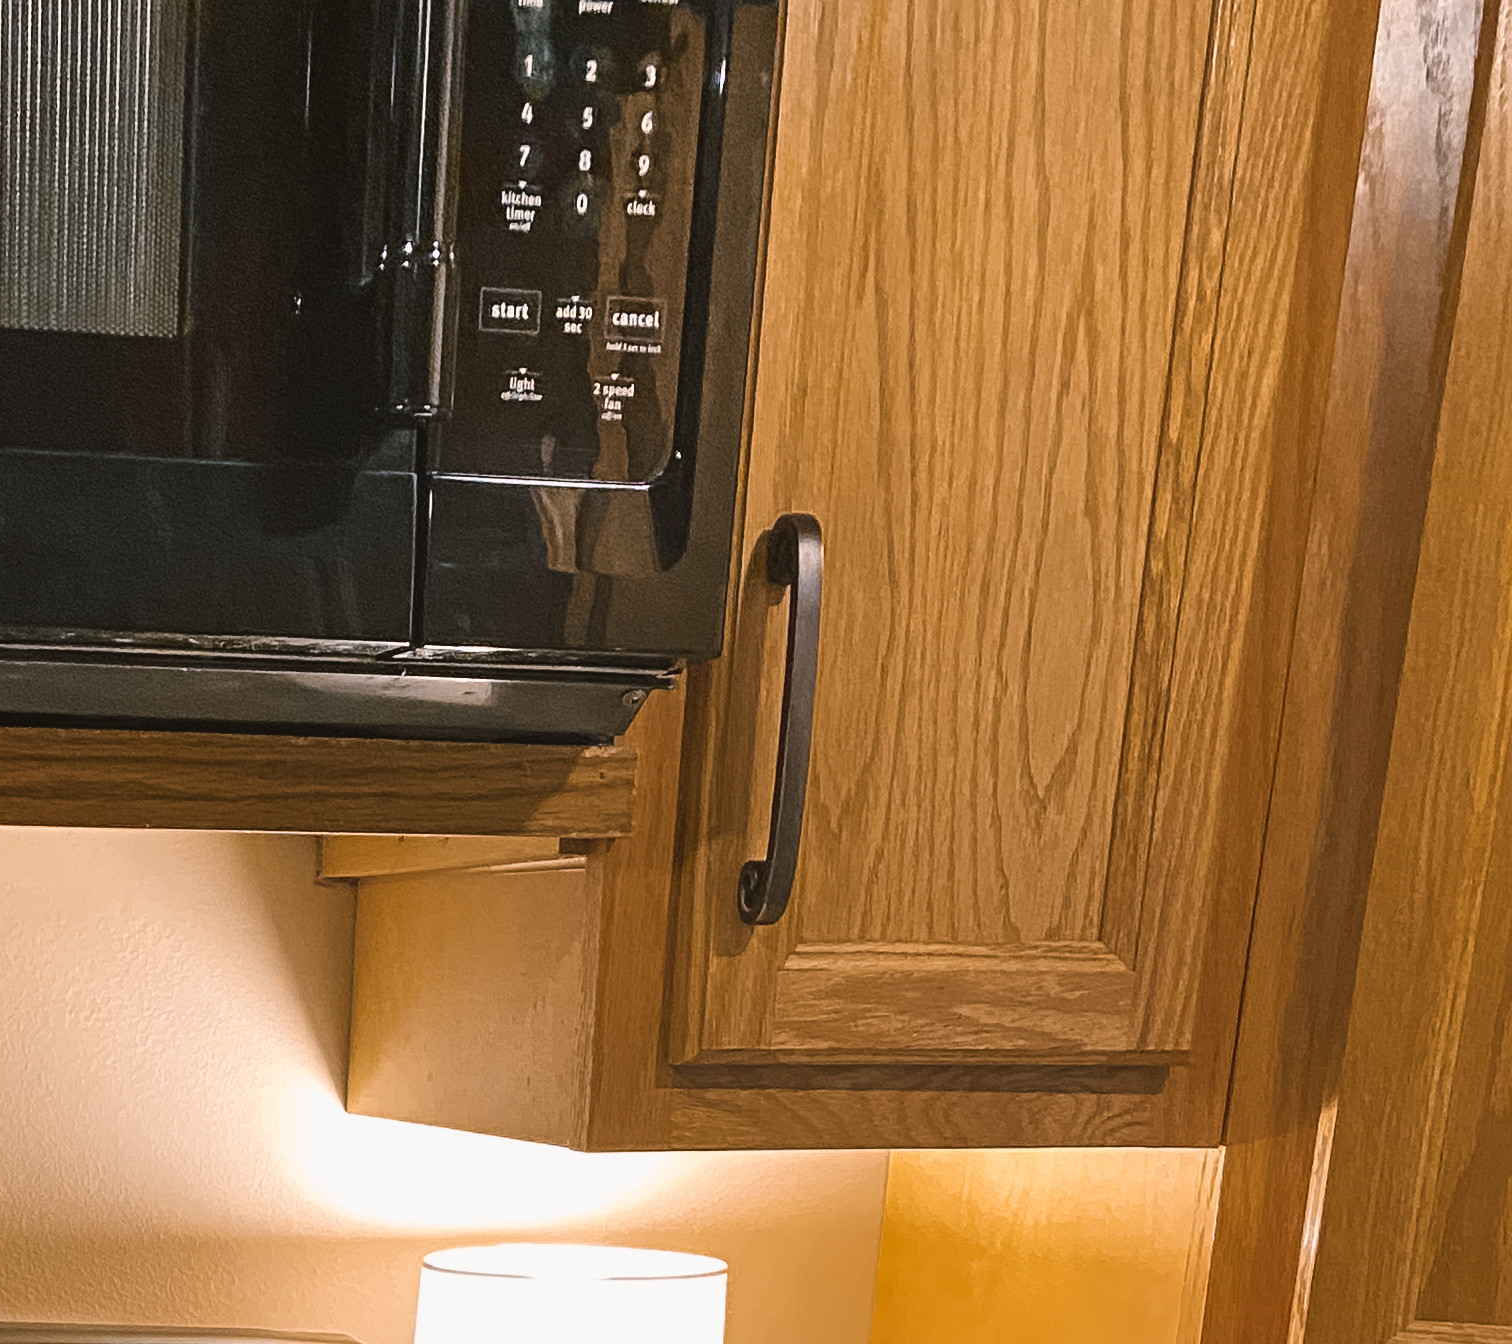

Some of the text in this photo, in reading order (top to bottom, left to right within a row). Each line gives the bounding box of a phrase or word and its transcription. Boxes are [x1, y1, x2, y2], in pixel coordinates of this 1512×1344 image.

[523, 55, 657, 88] 1 2 3
[521, 102, 653, 134] 4 5 6
[519, 144, 650, 176] 7 8 9
[501, 190, 542, 207] kitchen
[576, 193, 589, 215] 0
[506, 205, 536, 222] timer
[626, 200, 656, 216] clock
[491, 302, 529, 320] start
[555, 303, 593, 320] add 30
[563, 321, 583, 334] sec
[612, 310, 660, 330] cancel
[509, 375, 535, 393] light
[593, 382, 635, 399] 2 speed
[604, 396, 622, 410] fan
